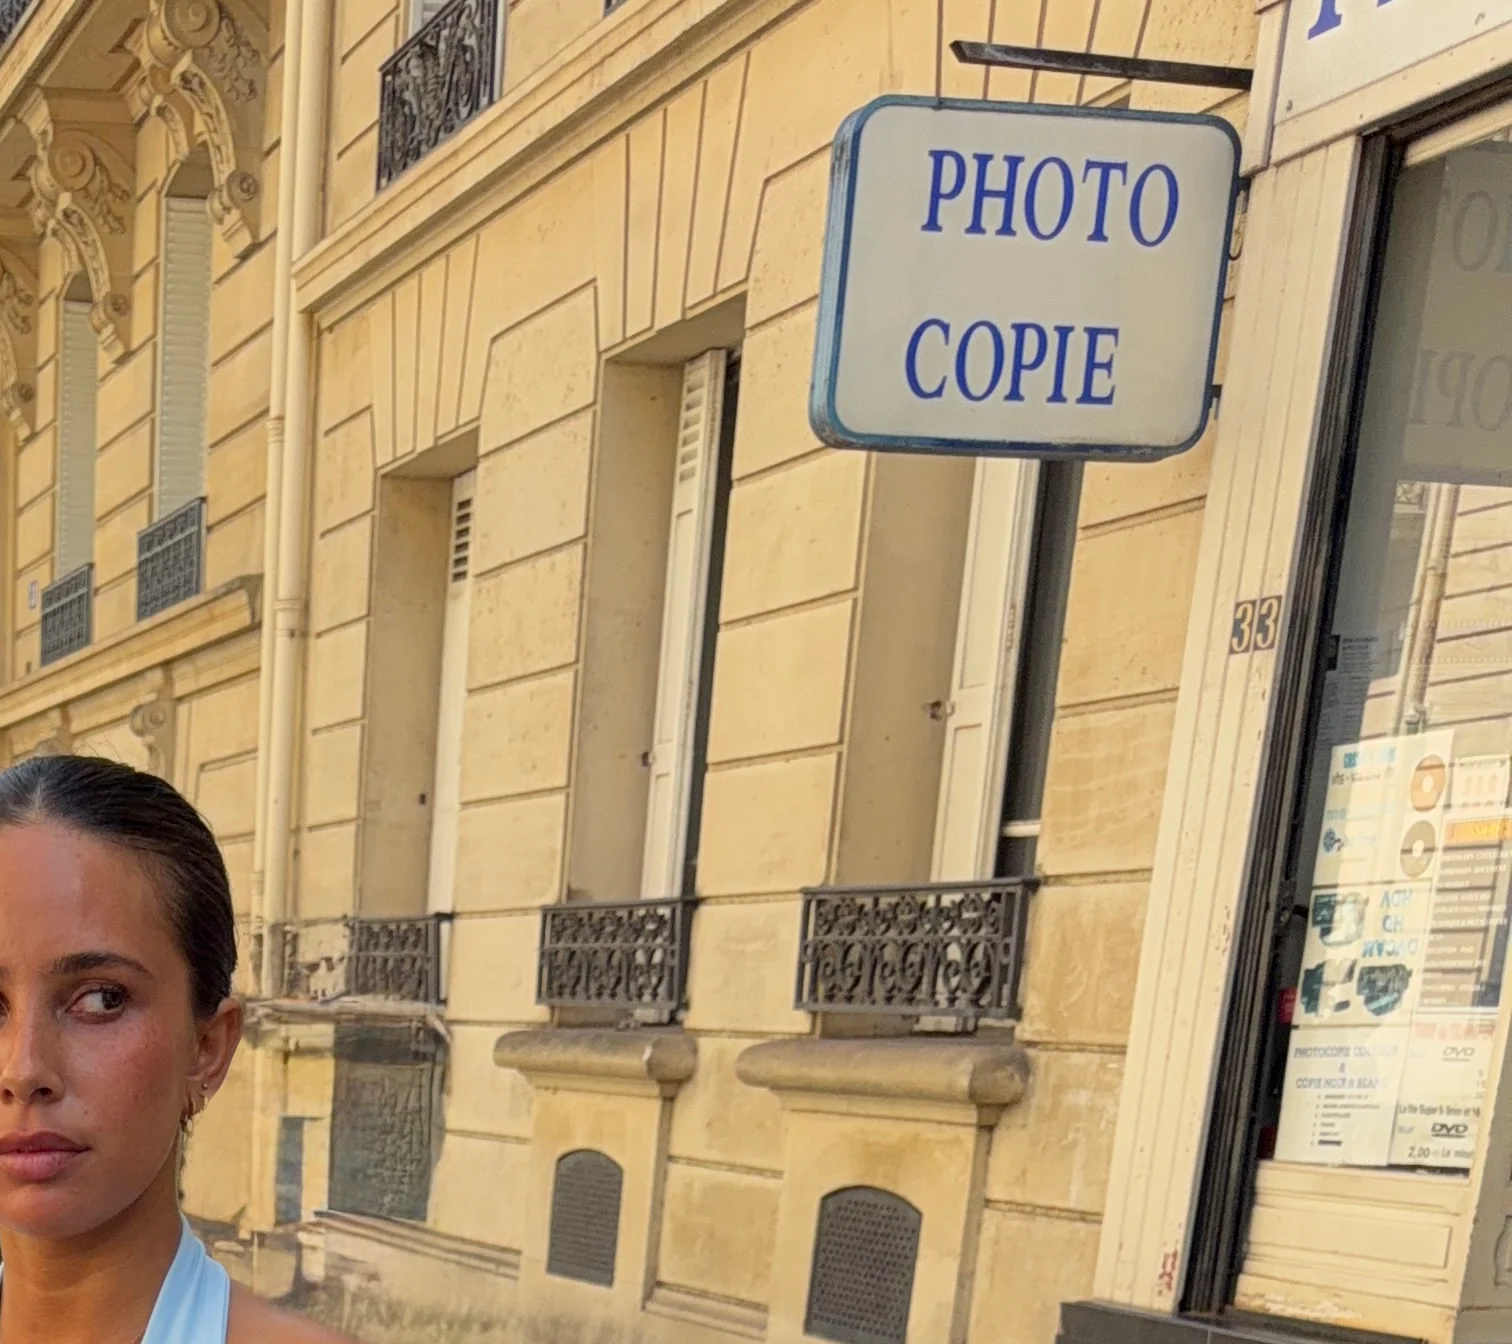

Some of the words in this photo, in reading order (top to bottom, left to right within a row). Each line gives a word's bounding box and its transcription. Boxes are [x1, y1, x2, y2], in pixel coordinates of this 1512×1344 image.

[920, 148, 1180, 248] PHOTO
[904, 318, 1120, 406] COPIE
[1231, 597, 1279, 653] 33
[1441, 1046, 1476, 1062] DVD
[1431, 1122, 1468, 1138] DVD
